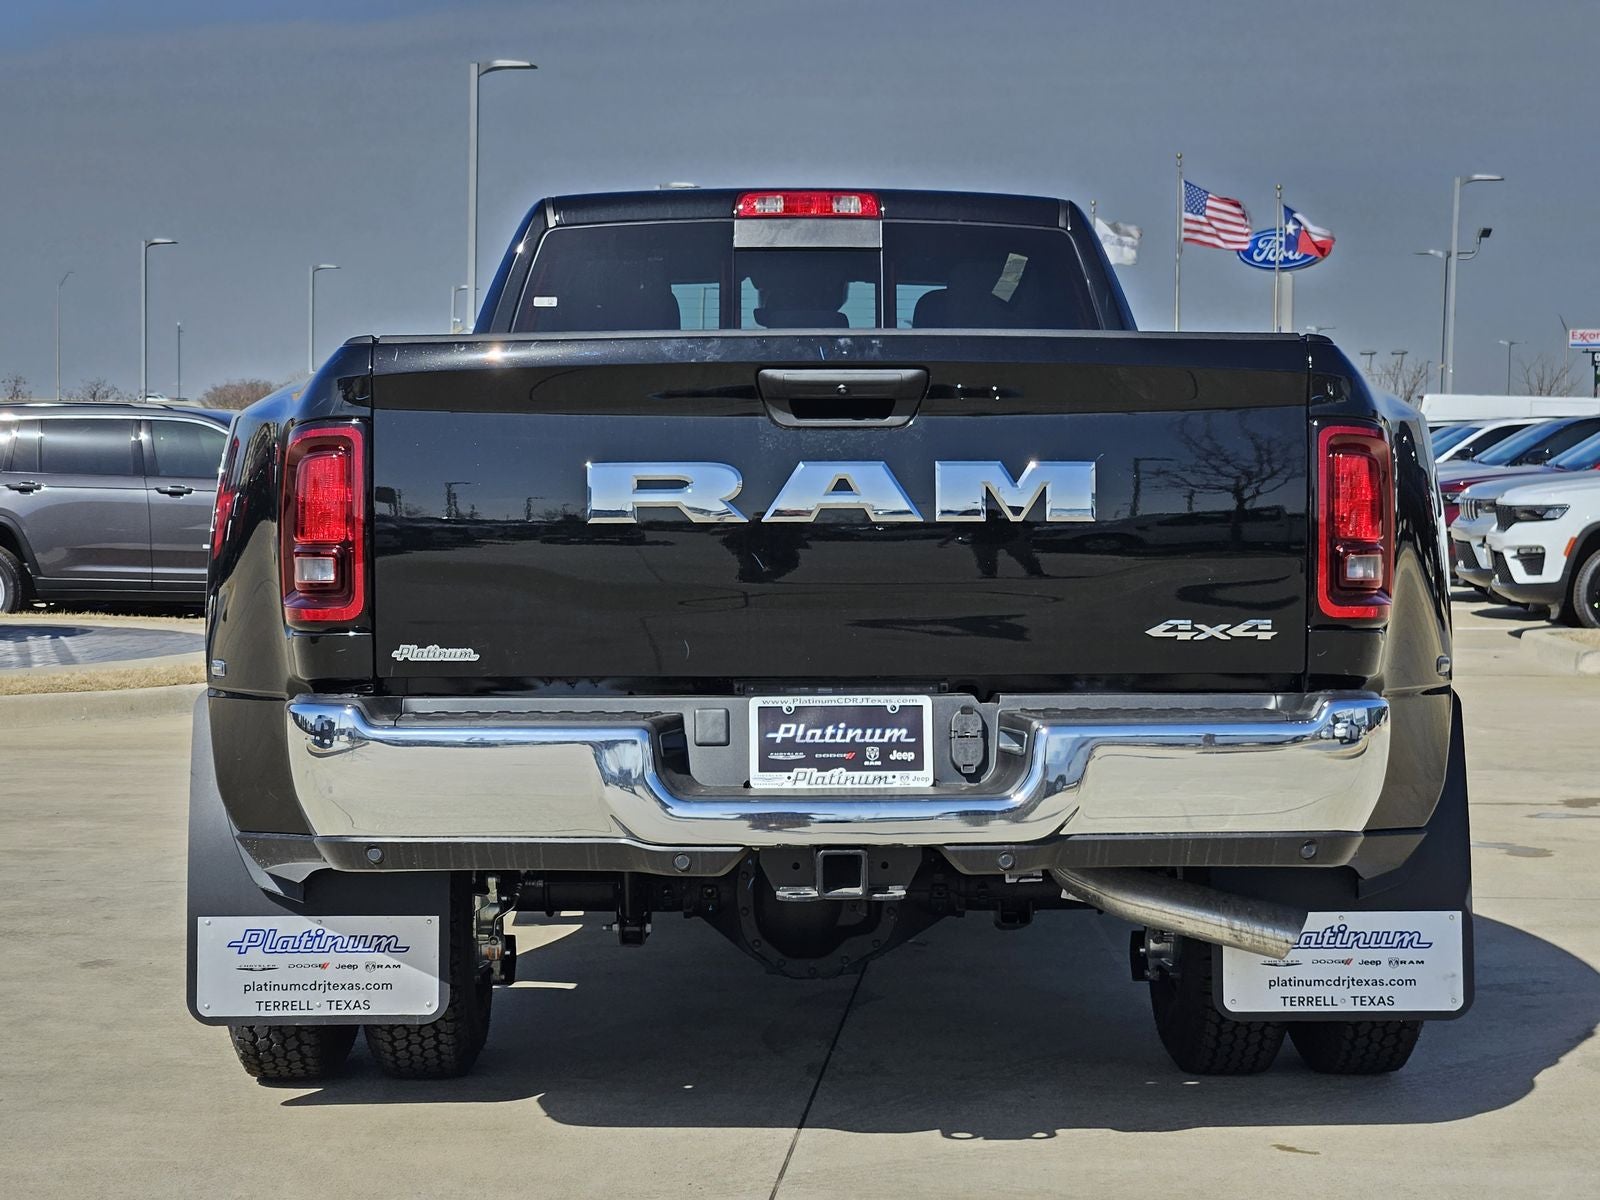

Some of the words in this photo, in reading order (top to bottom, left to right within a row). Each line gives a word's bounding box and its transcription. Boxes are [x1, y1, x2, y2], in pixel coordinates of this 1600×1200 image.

[587, 460, 1097, 523] RAM
[1144, 619, 1278, 640] 4x4
[391, 644, 480, 661] Platinum
[766, 722, 916, 743] Platinum
[889, 750, 915, 762] Jeep
[792, 771, 897, 786] Platinum
[227, 928, 410, 954] Platinum
[1291, 924, 1433, 949] atinum
[335, 963, 359, 971] Jeep
[1358, 959, 1382, 967] Jeep
[243, 981, 393, 994] platinumcdrjtexas.com
[1268, 976, 1417, 989] platinumcdrjtexas.com
[256, 1000, 314, 1011] TERRELL
[326, 1000, 371, 1010] TEXAS
[1281, 996, 1338, 1007] TERRELL
[1350, 996, 1395, 1006] TEXAS
